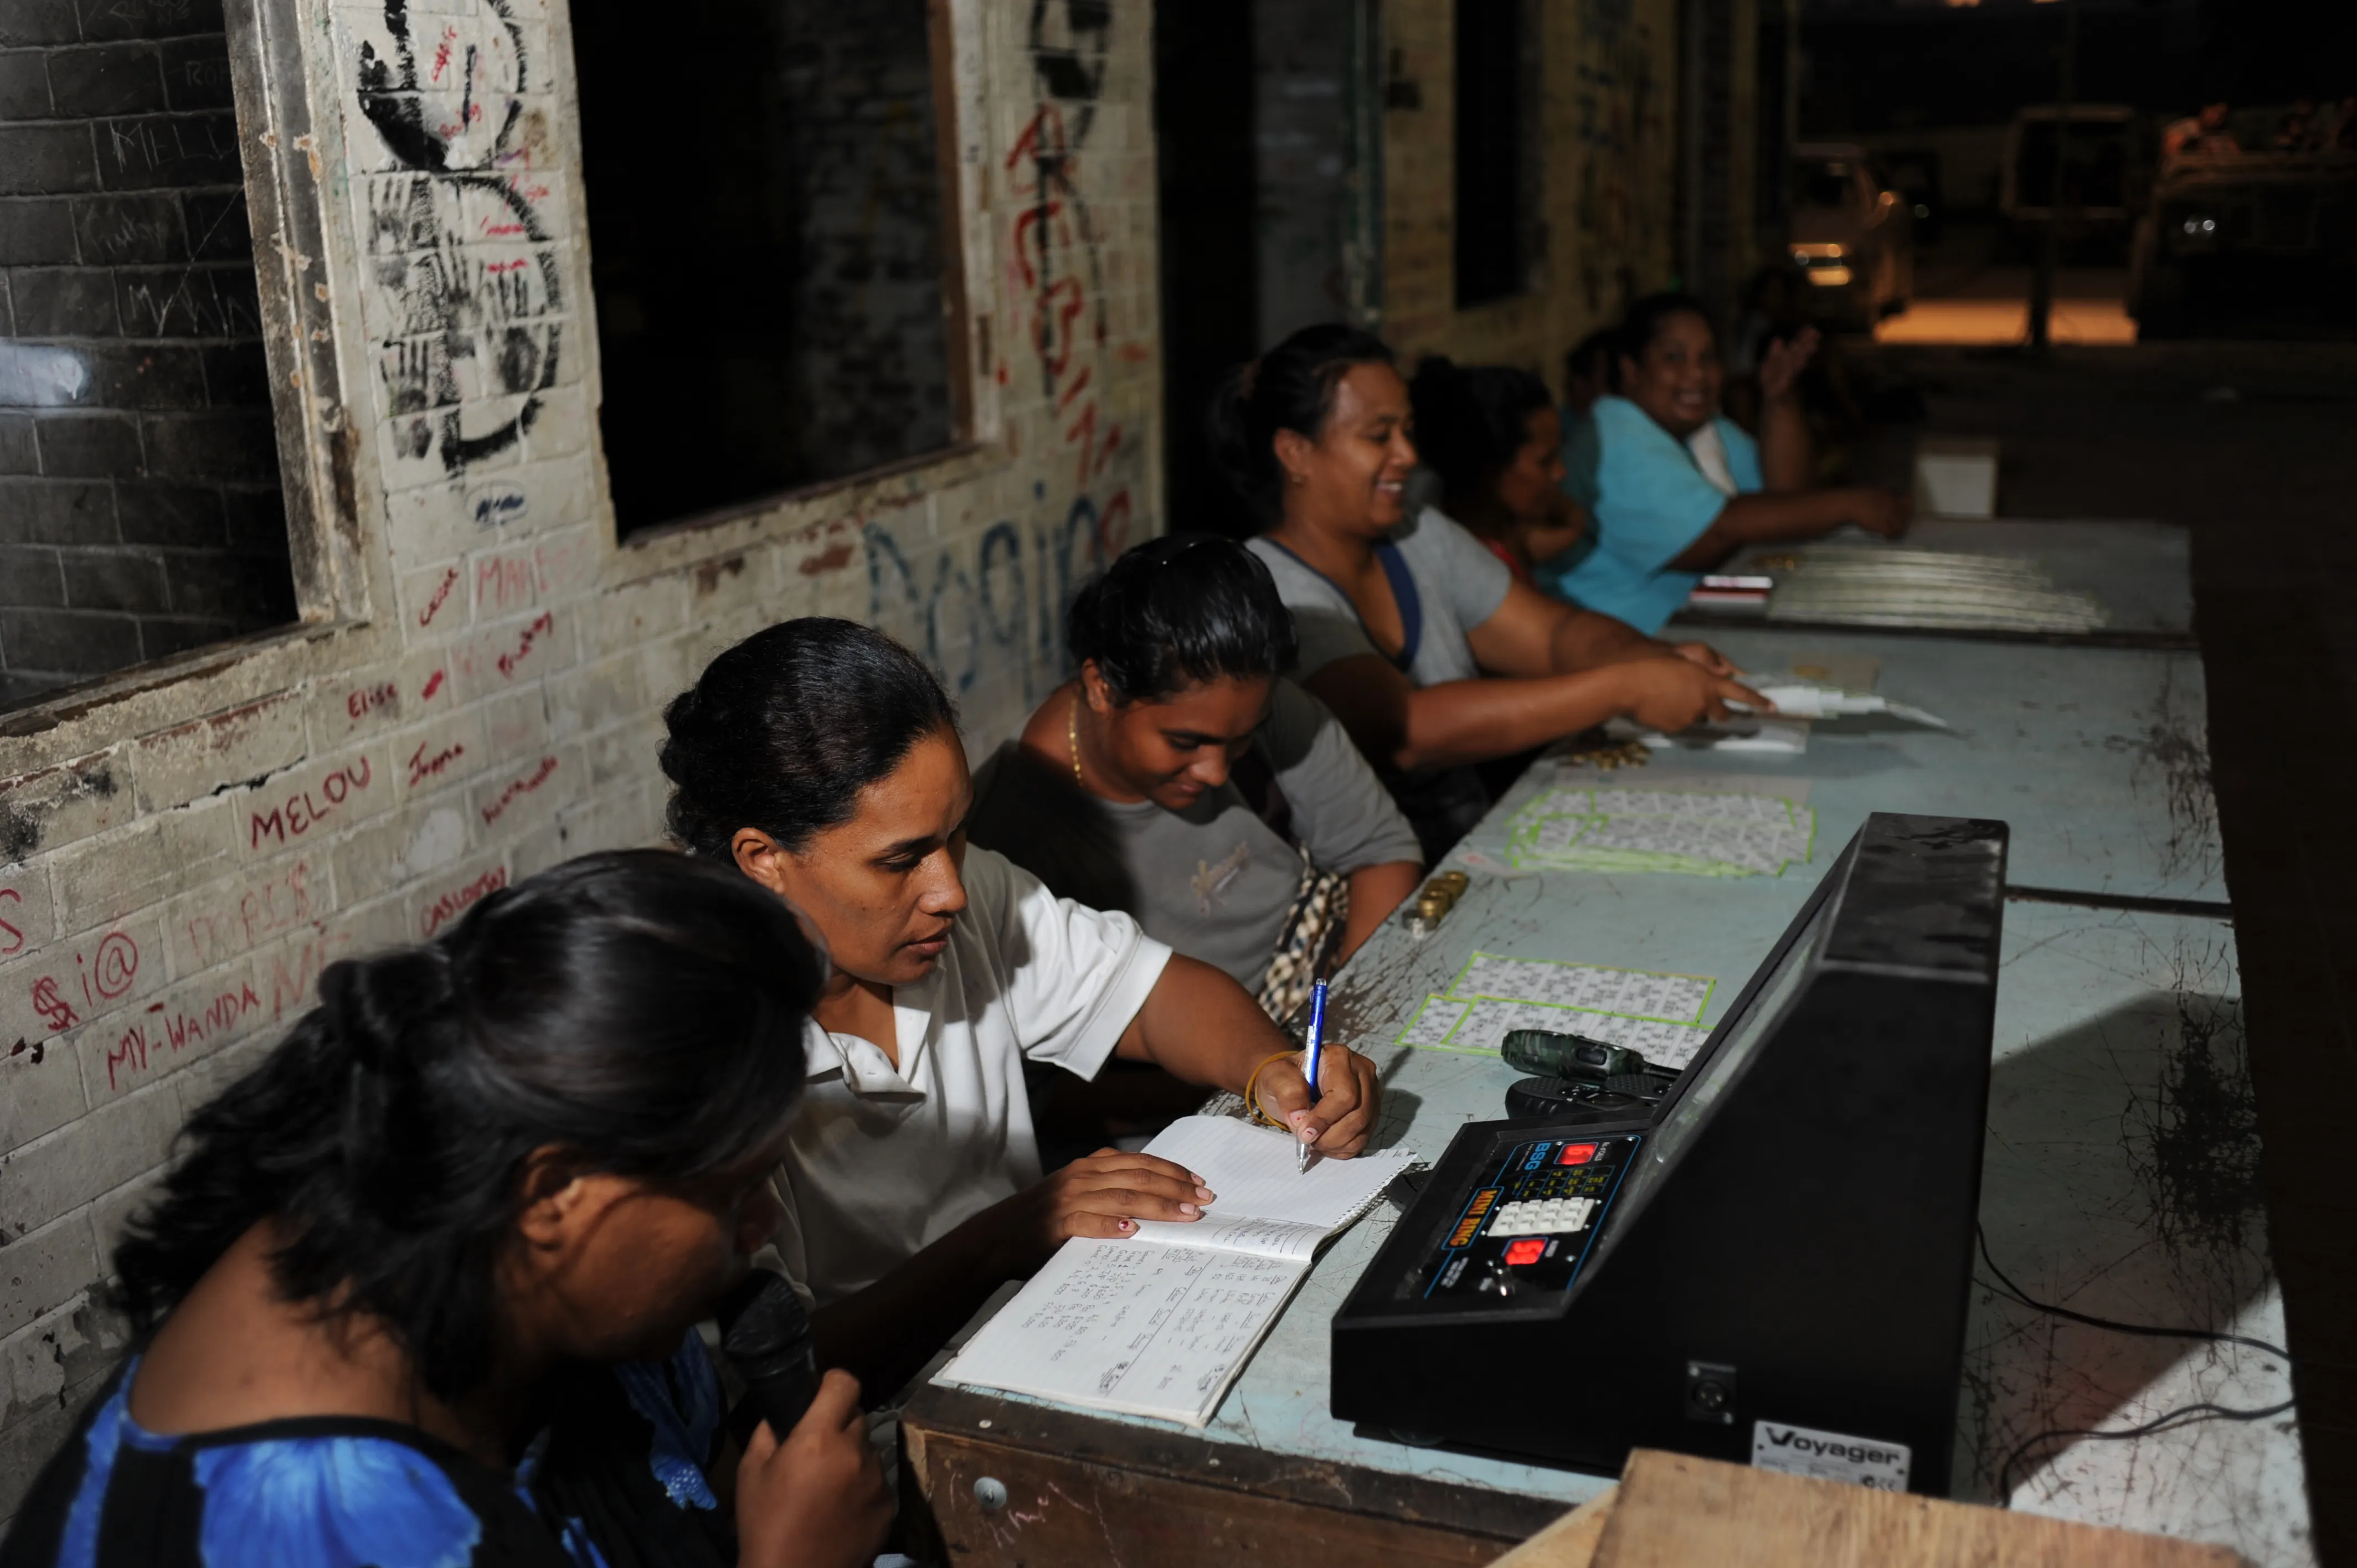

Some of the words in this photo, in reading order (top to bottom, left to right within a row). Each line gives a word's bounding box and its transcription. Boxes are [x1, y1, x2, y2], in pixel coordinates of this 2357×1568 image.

[1524, 1142, 1552, 1171] BSG
[1467, 1189, 1499, 1216] MINI
[1766, 1426, 1901, 1464] Voyager
